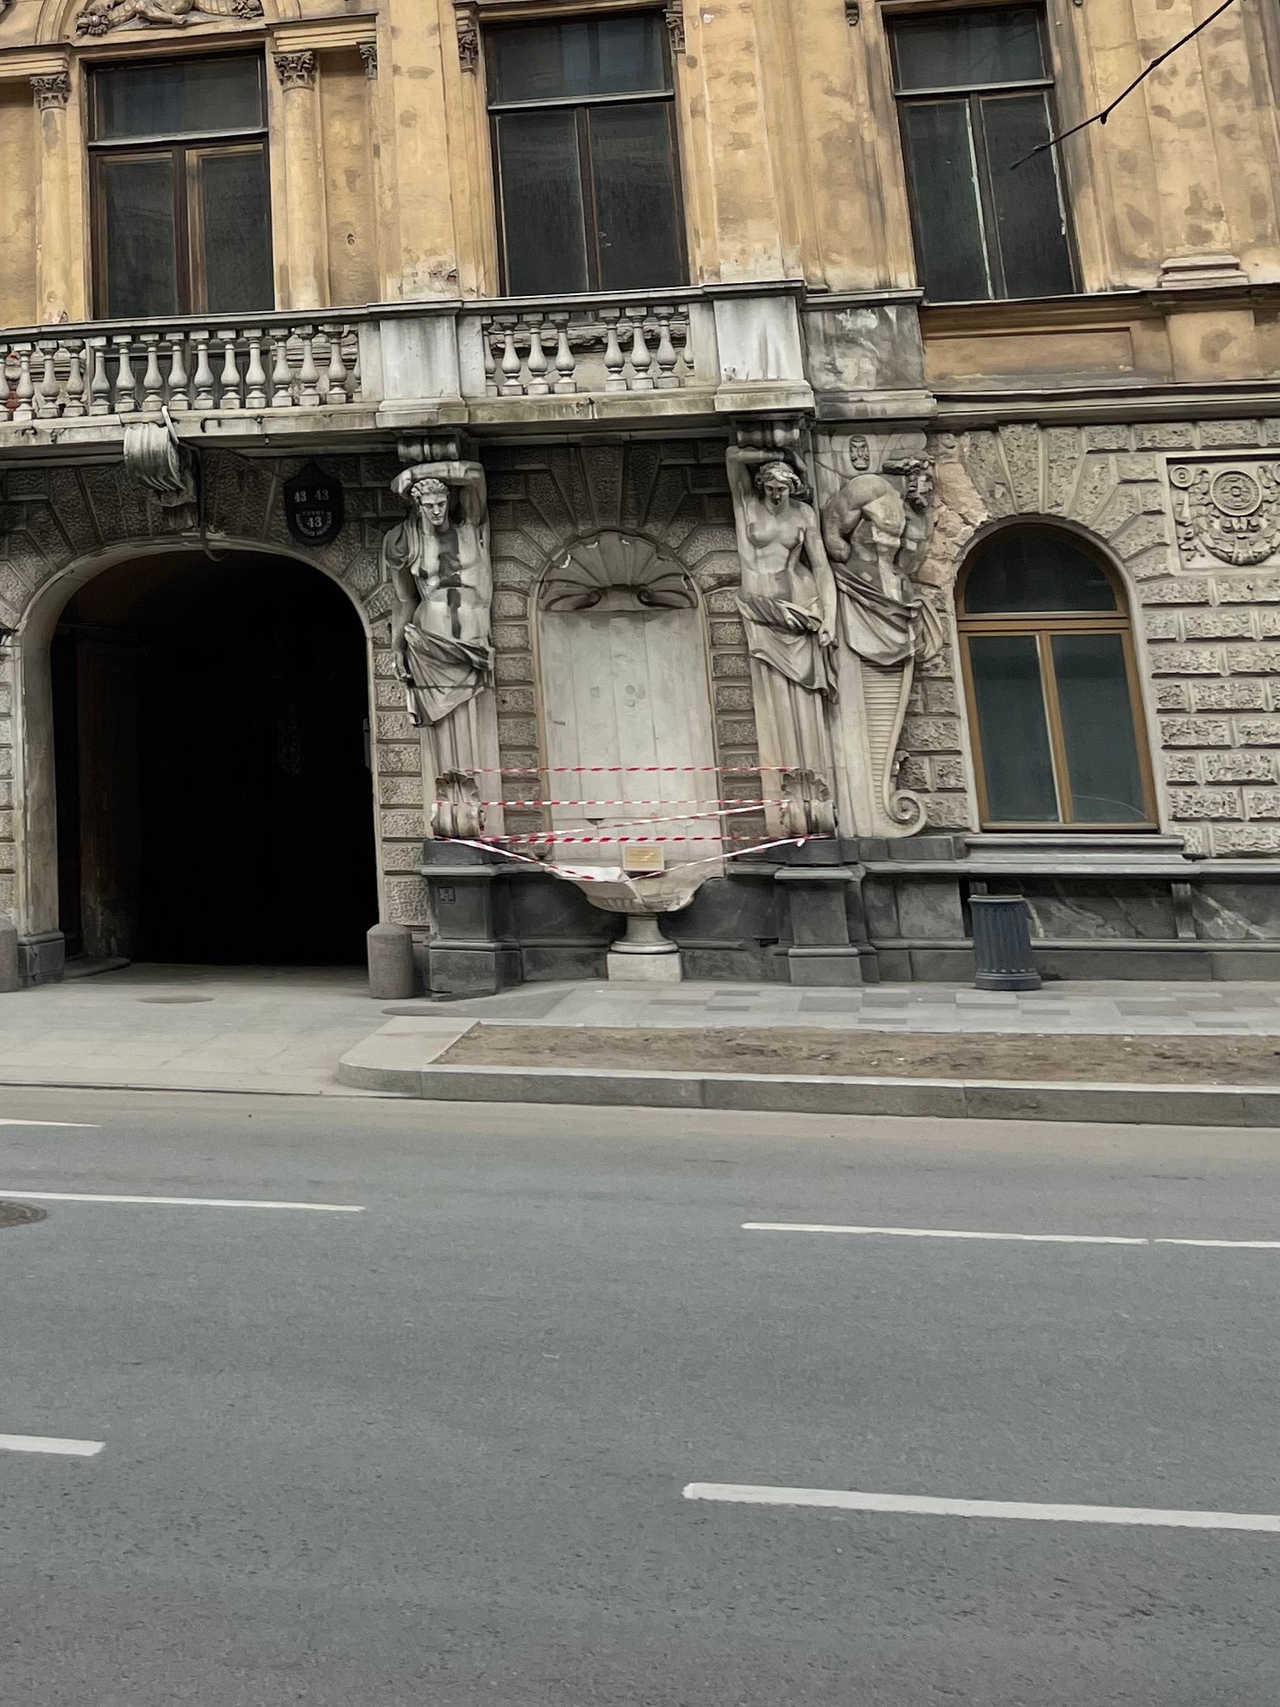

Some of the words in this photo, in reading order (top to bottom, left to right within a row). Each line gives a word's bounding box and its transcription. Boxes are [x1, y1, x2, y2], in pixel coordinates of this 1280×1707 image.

[294, 490, 307, 502] 43
[315, 489, 329, 501] 43
[306, 516, 322, 528] 43
